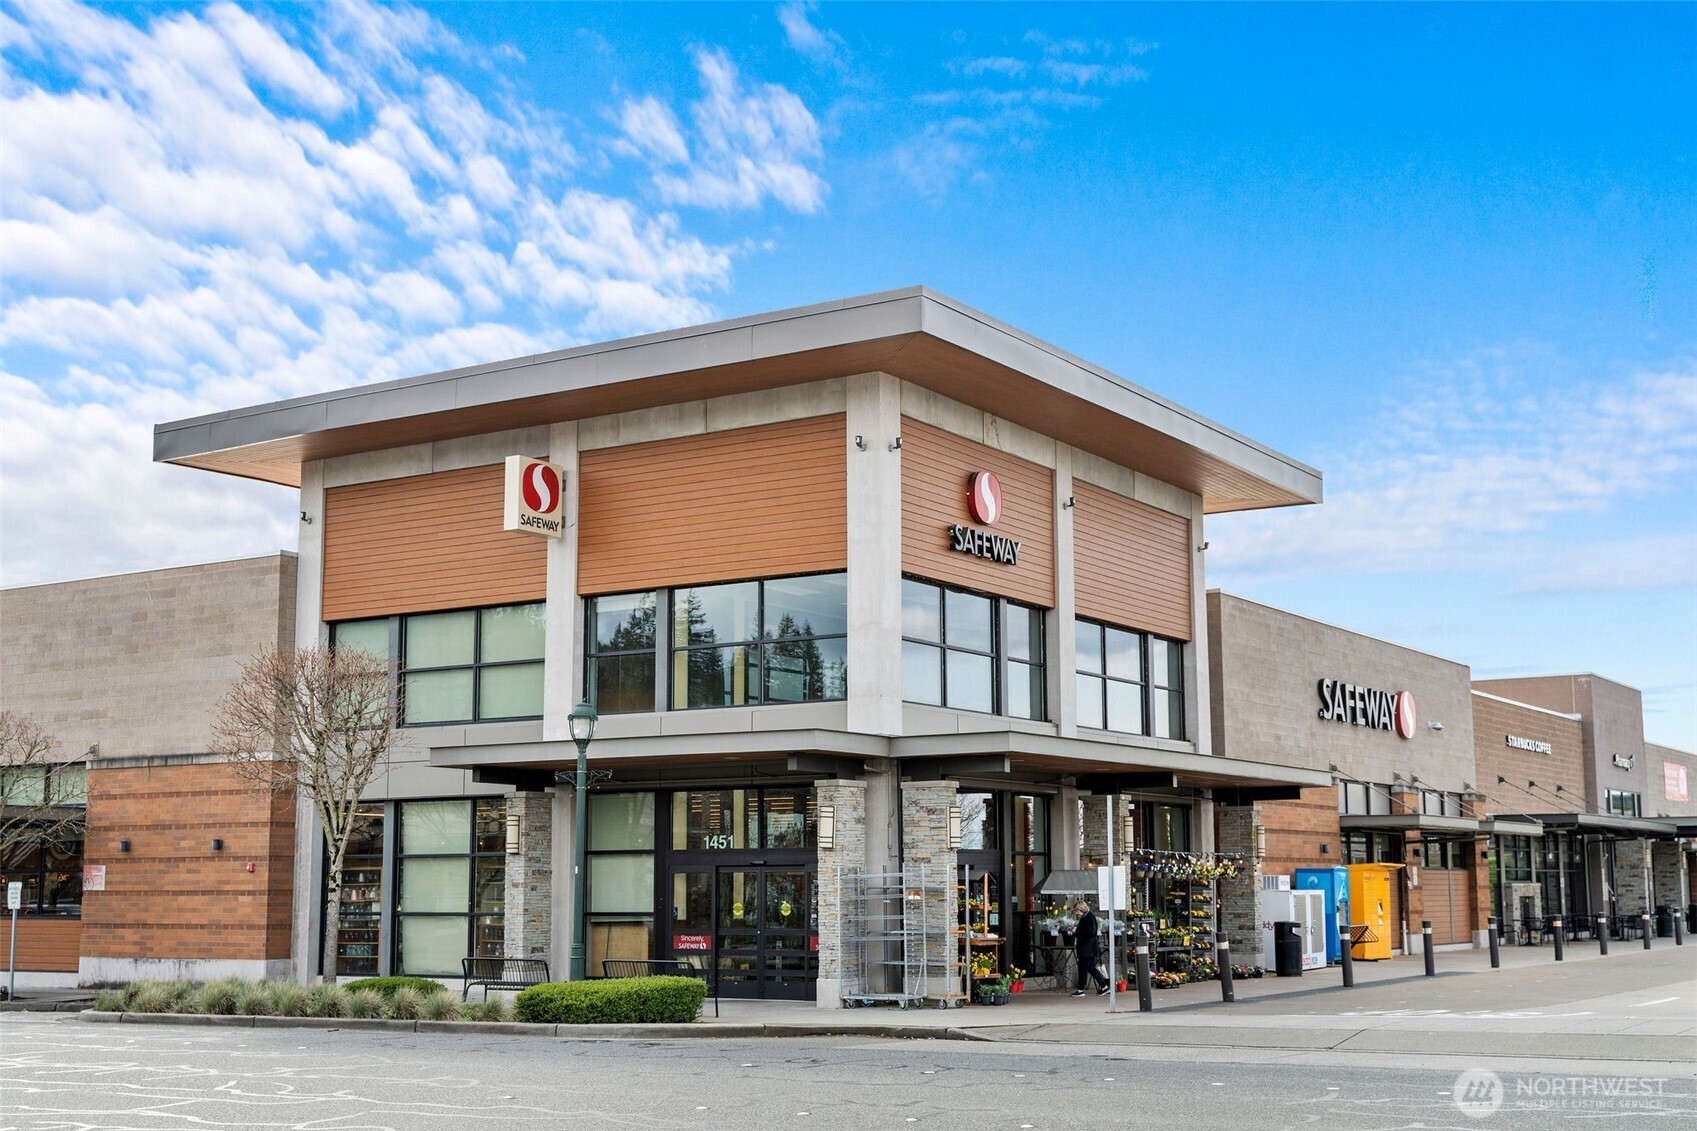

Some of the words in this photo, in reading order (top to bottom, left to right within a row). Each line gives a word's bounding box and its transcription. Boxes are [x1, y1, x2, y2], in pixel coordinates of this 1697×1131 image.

[520, 514, 560, 532] SAFEWAY
[953, 524, 1021, 565] SAFEWAY
[1319, 678, 1398, 731] SAFEWAY
[1507, 734, 1535, 752] STARBUCKS
[1535, 740, 1552, 755] COFFEE
[703, 835, 733, 849] 1451
